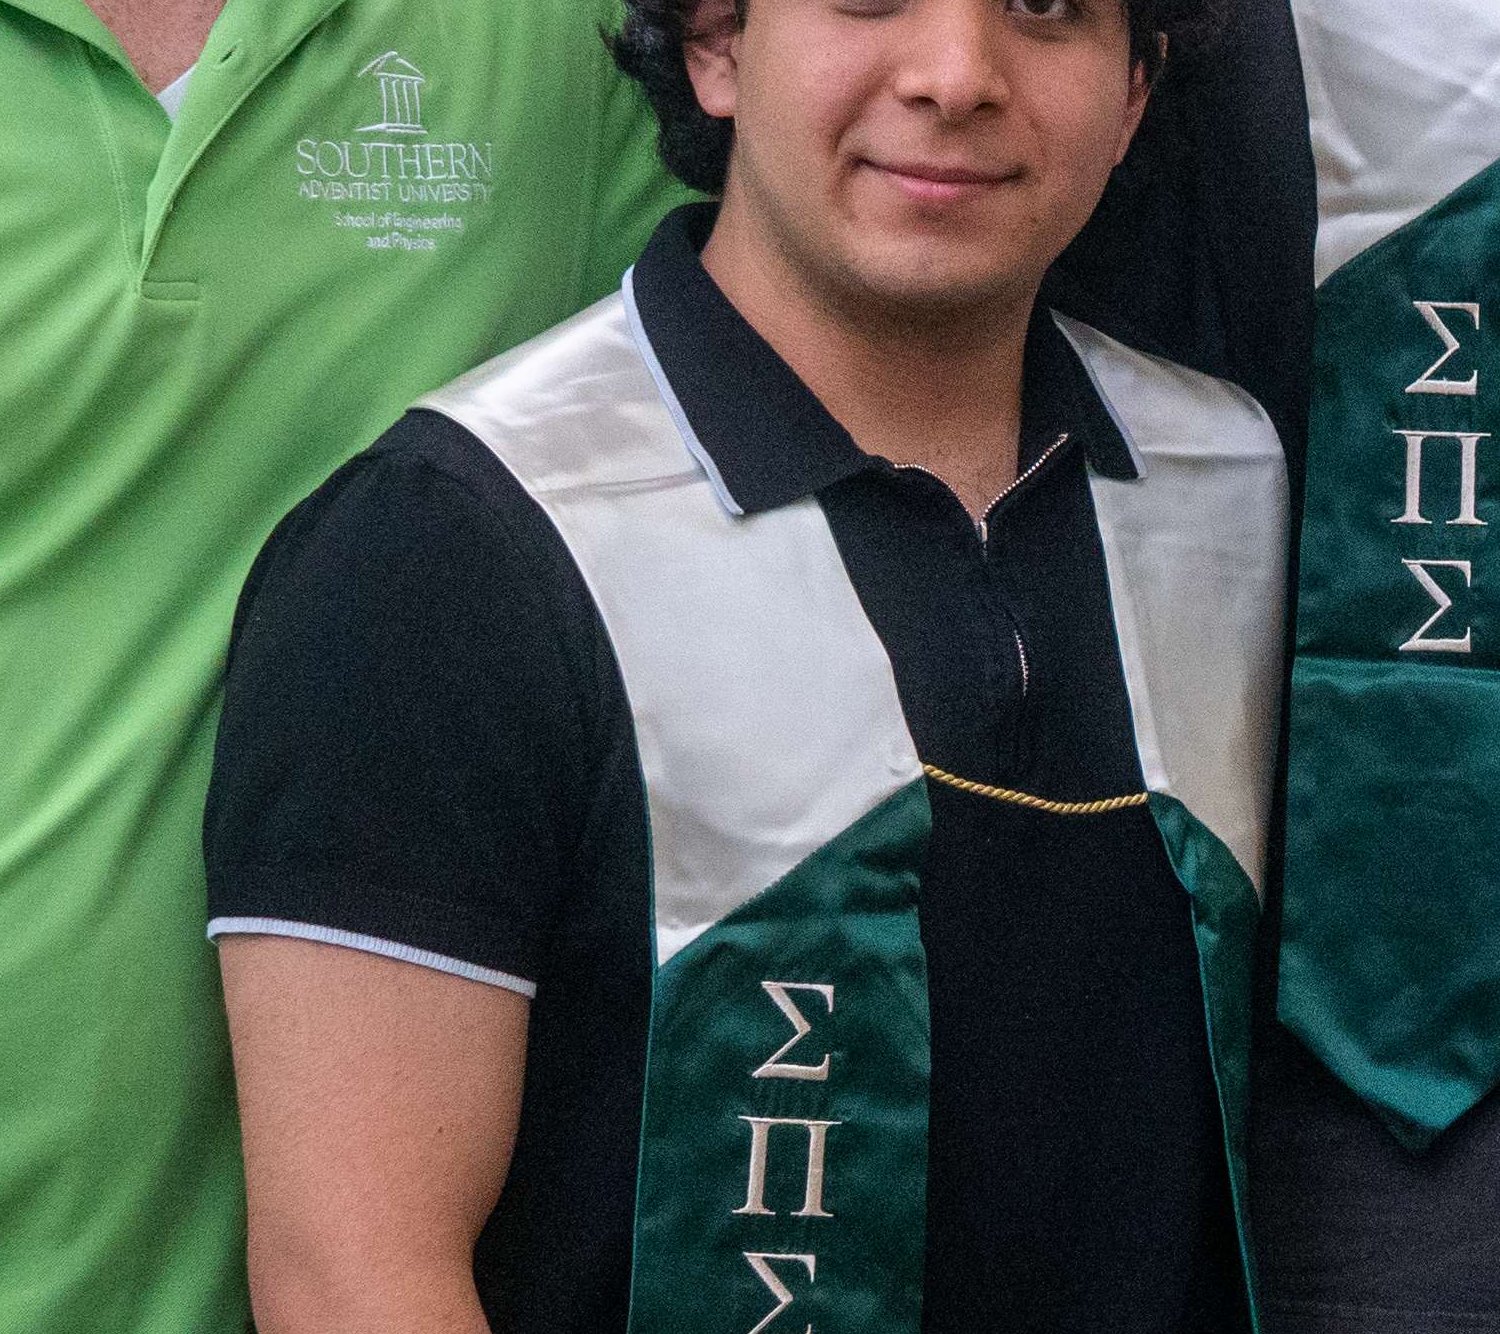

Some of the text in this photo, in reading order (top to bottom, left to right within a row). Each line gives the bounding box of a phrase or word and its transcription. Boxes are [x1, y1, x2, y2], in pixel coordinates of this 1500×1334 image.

[296, 138, 493, 181] SOUTHERN
[299, 179, 492, 203] ADVENTIST UNIVERSITY
[333, 211, 376, 228] School
[365, 232, 389, 248] and
